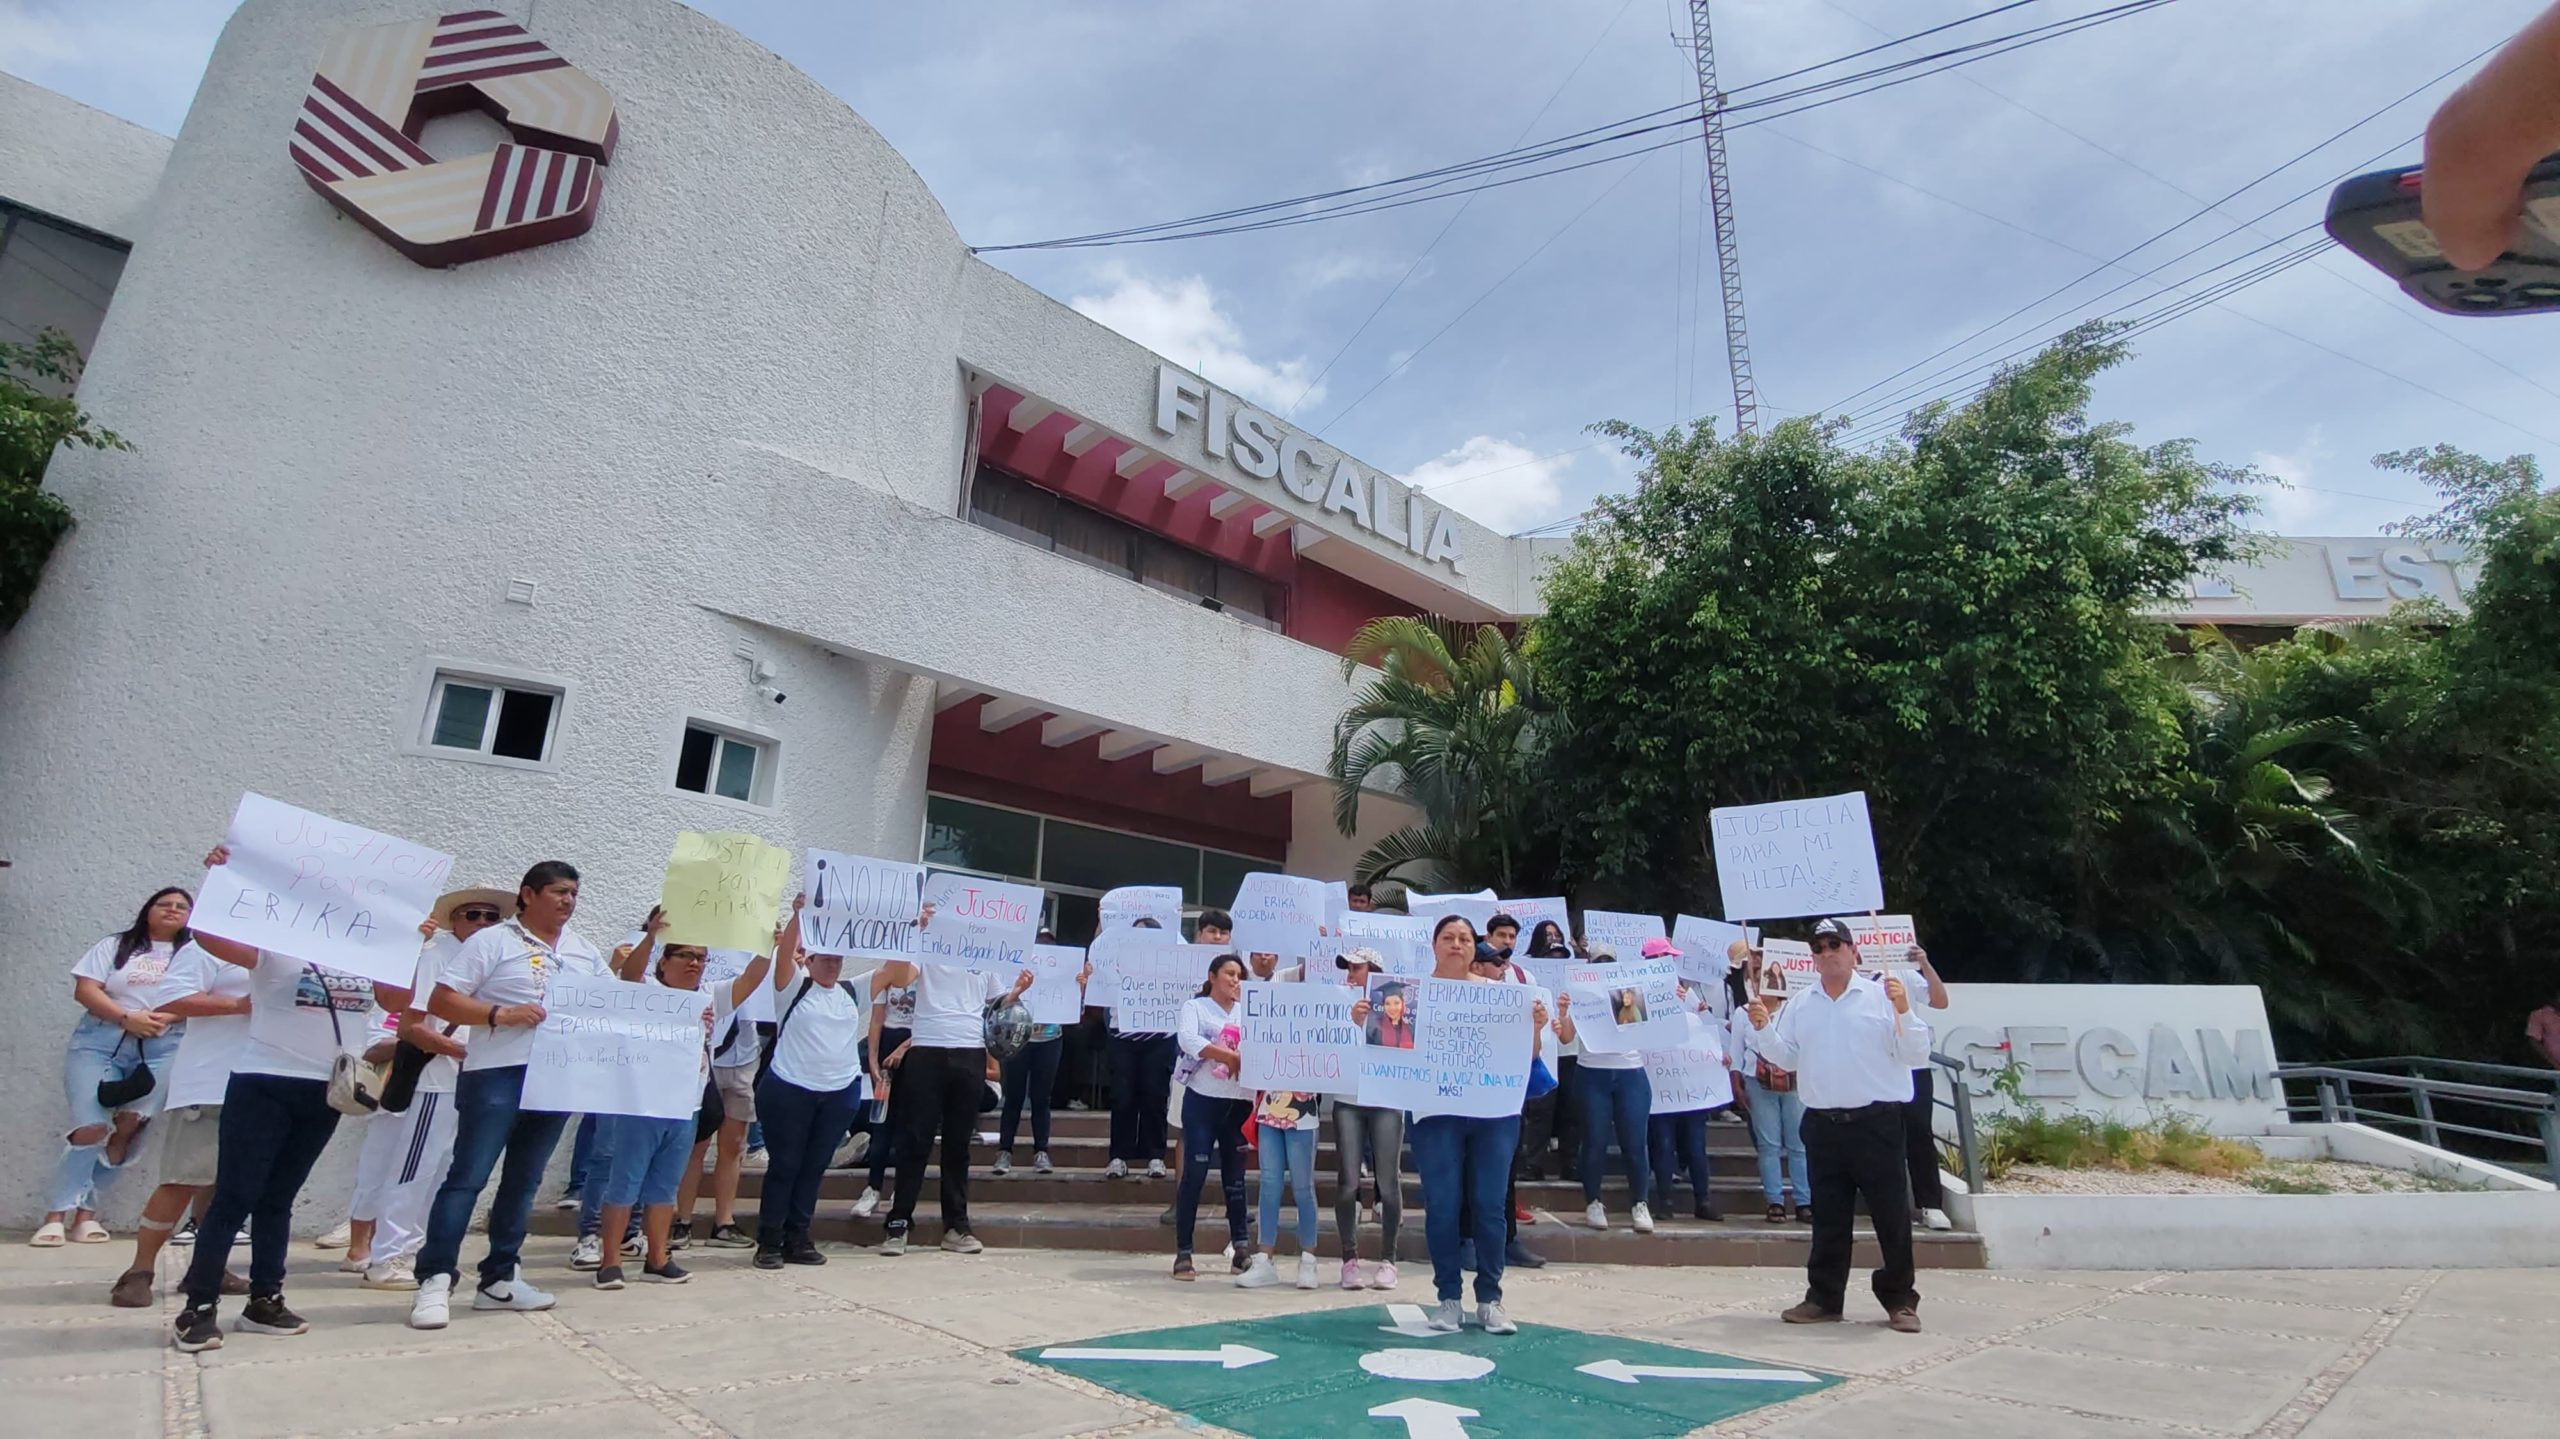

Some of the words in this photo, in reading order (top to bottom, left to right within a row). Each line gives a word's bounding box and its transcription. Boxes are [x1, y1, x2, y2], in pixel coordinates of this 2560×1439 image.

[1155, 363, 1467, 577] FISCALÍA
[1730, 841, 1782, 865] PARA
[1803, 831, 1834, 854] MI
[290, 854, 388, 896] Para
[1742, 856, 1817, 891] HIJA!
[1246, 878, 1310, 897] JUSTICIA
[955, 887, 1029, 925] Justicia
[1263, 896, 1296, 909] ERIKA
[229, 888, 378, 939] ERIKA
[1234, 910, 1247, 919] NO
[802, 915, 831, 948] UN
[835, 917, 918, 954] ACCIDENTE
[1348, 919, 1380, 937] Erika
[921, 932, 952, 956] Erika
[1855, 932, 1915, 946] JUSTICIA
[1682, 956, 1727, 978] ERIK
[1782, 957, 1816, 973] JUSTI
[1121, 975, 1148, 992] Que
[1148, 979, 1158, 990] el
[1122, 996, 1136, 1006] no
[1138, 995, 1148, 1006] te
[1247, 989, 1287, 1018] Erika
[1293, 1002, 1308, 1018] no
[1428, 982, 1468, 1003] ERIKA
[1469, 985, 1524, 1009] DELGADO
[1427, 1005, 1442, 1022] Te
[560, 1016, 614, 1036] PARA
[1241, 1025, 1248, 1041] a
[1253, 1020, 1283, 1044] Erika
[1289, 1021, 1301, 1044] la
[1307, 1022, 1358, 1046] mataron
[1426, 1024, 1446, 1039] tus
[1449, 1026, 1487, 1040] METAS
[1426, 1038, 1446, 1051] tus
[1425, 1051, 1439, 1065] tu
[1643, 1048, 1719, 1068] USTICIA
[1436, 1070, 1449, 1085] LA
[1453, 1072, 1473, 1085] VOZ
[1478, 1073, 1502, 1087] UNA
[1505, 1074, 1524, 1088] VEZ
[1655, 1067, 1690, 1078] PARA
[1659, 1085, 1720, 1105] RIKA
